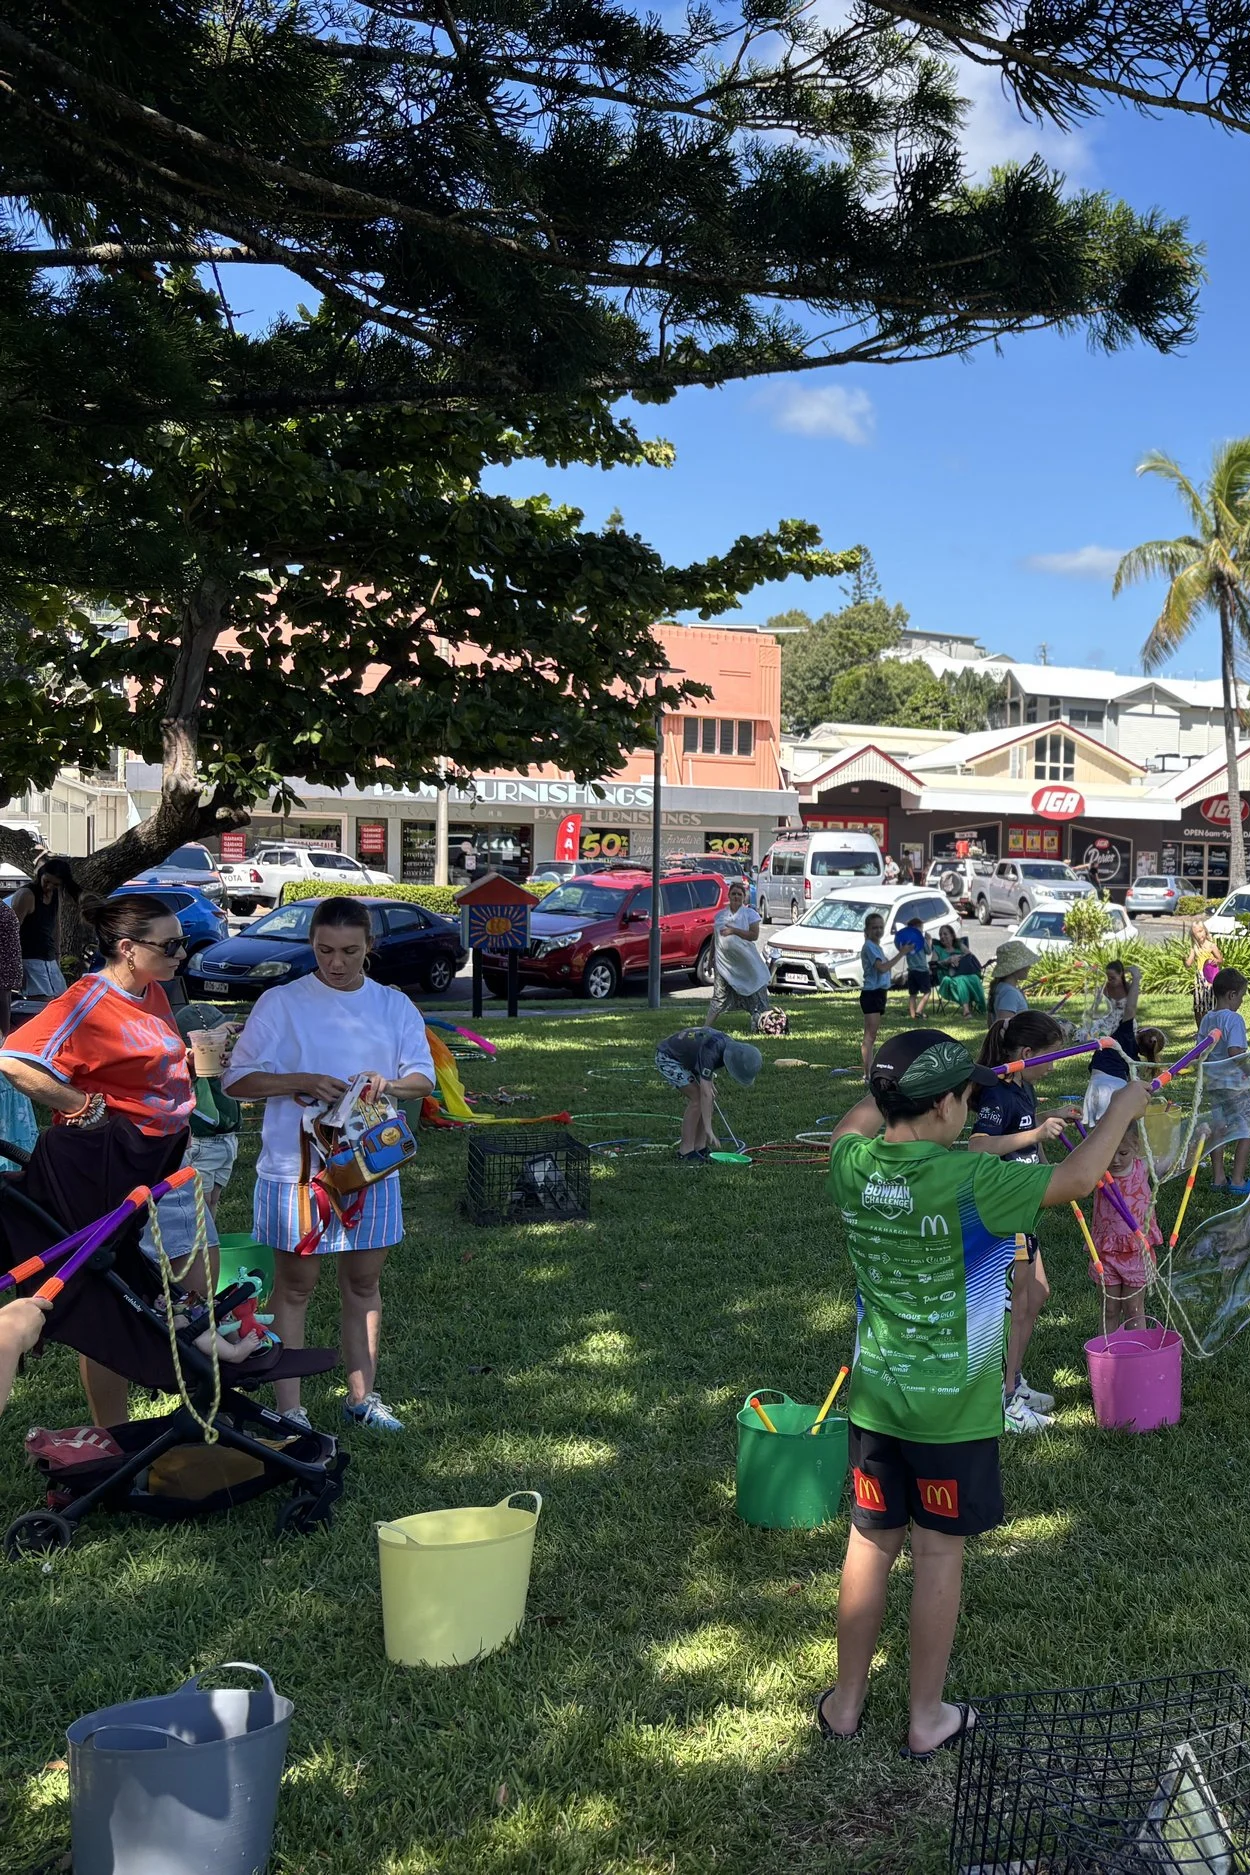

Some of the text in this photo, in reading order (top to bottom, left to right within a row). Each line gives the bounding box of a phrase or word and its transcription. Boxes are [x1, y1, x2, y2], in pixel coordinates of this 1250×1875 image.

[1037, 791, 1080, 813] IGA
[584, 809, 702, 827] FURNISINGS
[1184, 829, 1204, 837] OPEN
[1205, 830, 1232, 840] 6am-9p
[864, 1182, 911, 1200] BOWMAN
[864, 1196, 911, 1209] CHALLENGE
